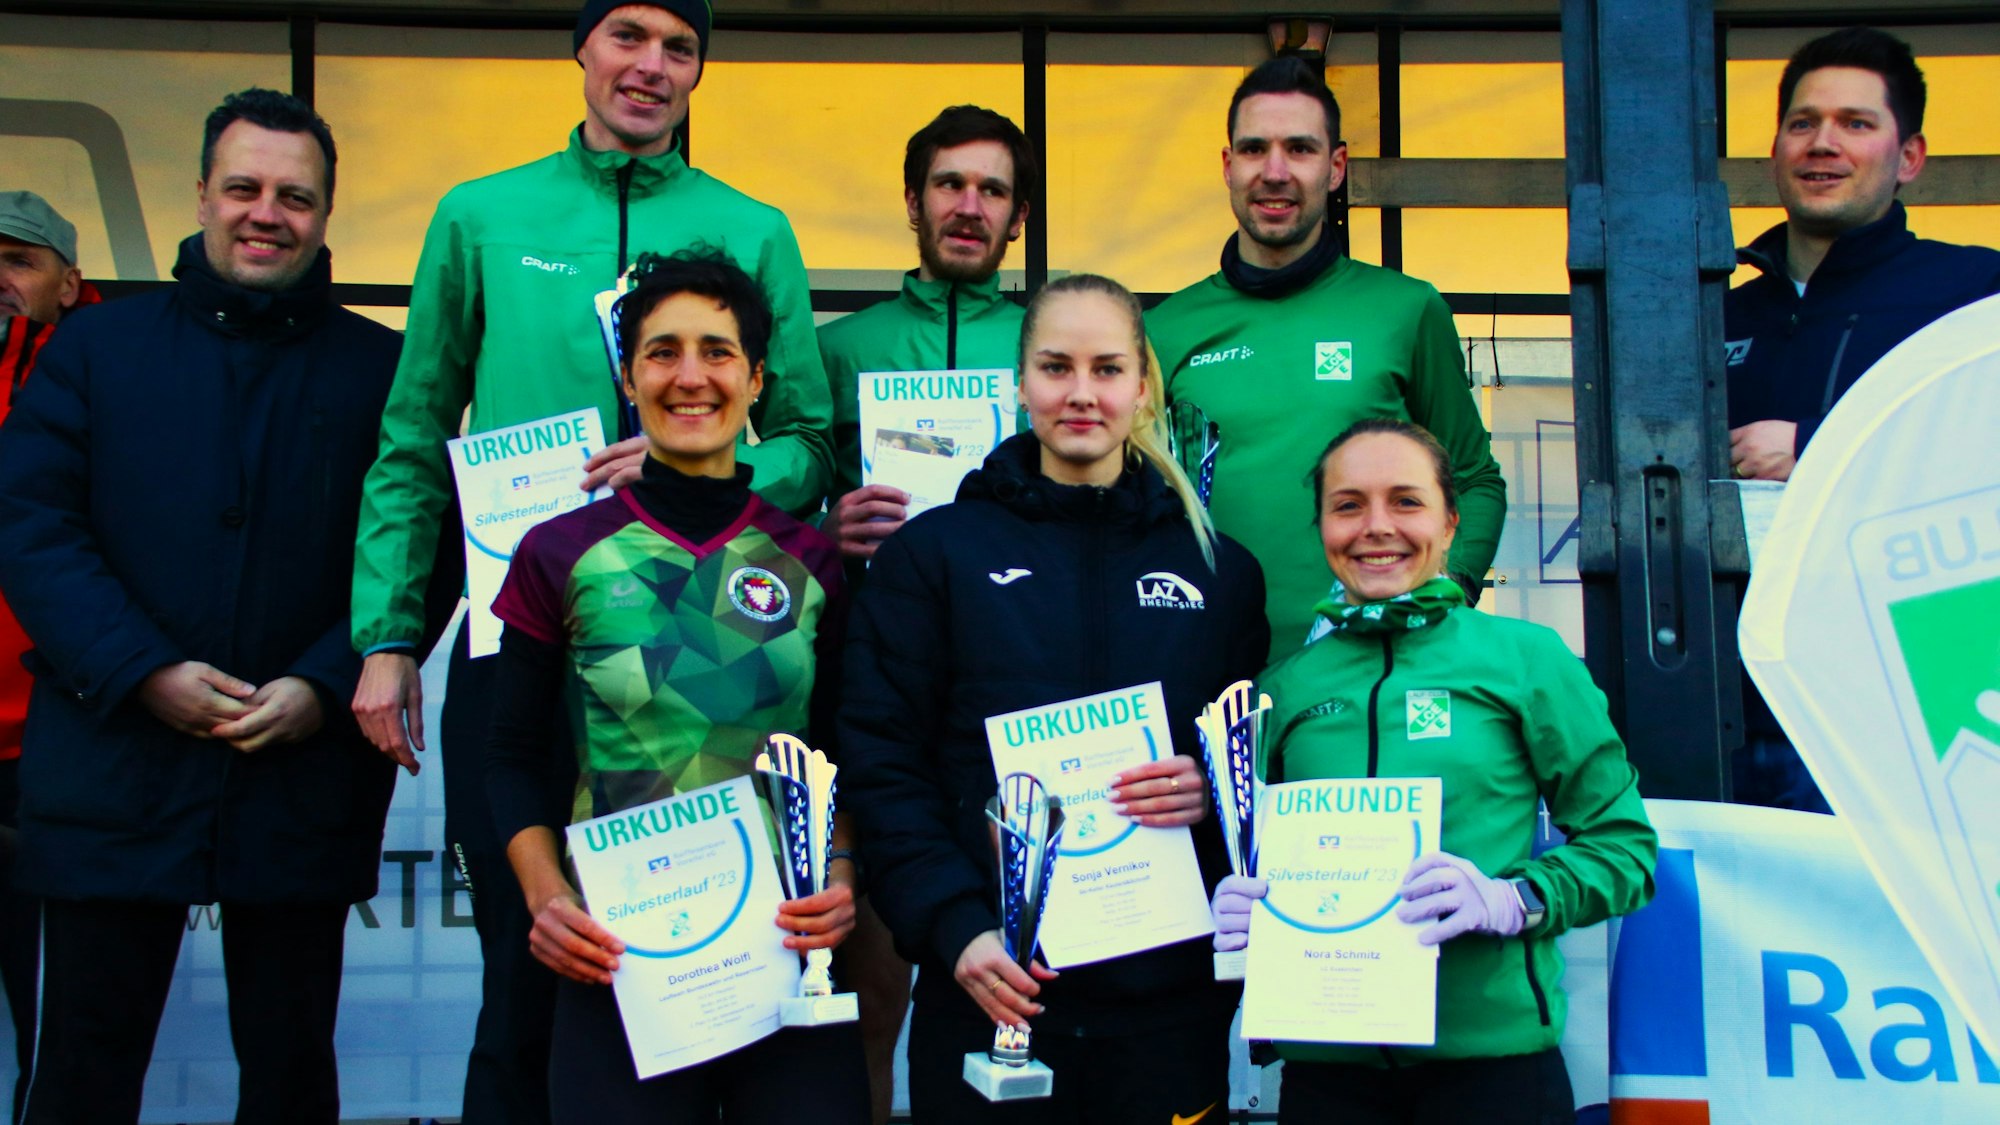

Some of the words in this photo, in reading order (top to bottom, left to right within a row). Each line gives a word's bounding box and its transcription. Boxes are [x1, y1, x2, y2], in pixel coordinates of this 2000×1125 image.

[521, 256, 568, 273] CRAFT
[1189, 348, 1239, 367] CRAFT
[873, 374, 1000, 401] URKUNDE
[462, 417, 589, 467] URKUNDE
[475, 499, 560, 527] Silvesterlauf
[1136, 580, 1179, 601] LAZ
[1139, 598, 1205, 610] RHEIN-SIEG
[1003, 693, 1150, 747] URKUNDE
[1276, 786, 1423, 816] URKUNDE
[585, 787, 740, 852] URKUNDE
[1071, 871, 1102, 884] Sonja
[1104, 860, 1151, 876] Vernikov
[1267, 868, 1371, 882] Silvesterlauf
[607, 879, 710, 922] Silvesterlauf
[1304, 949, 1331, 959] Nora
[1335, 949, 1381, 960] Schmitz
[668, 963, 720, 986] Dorothea
